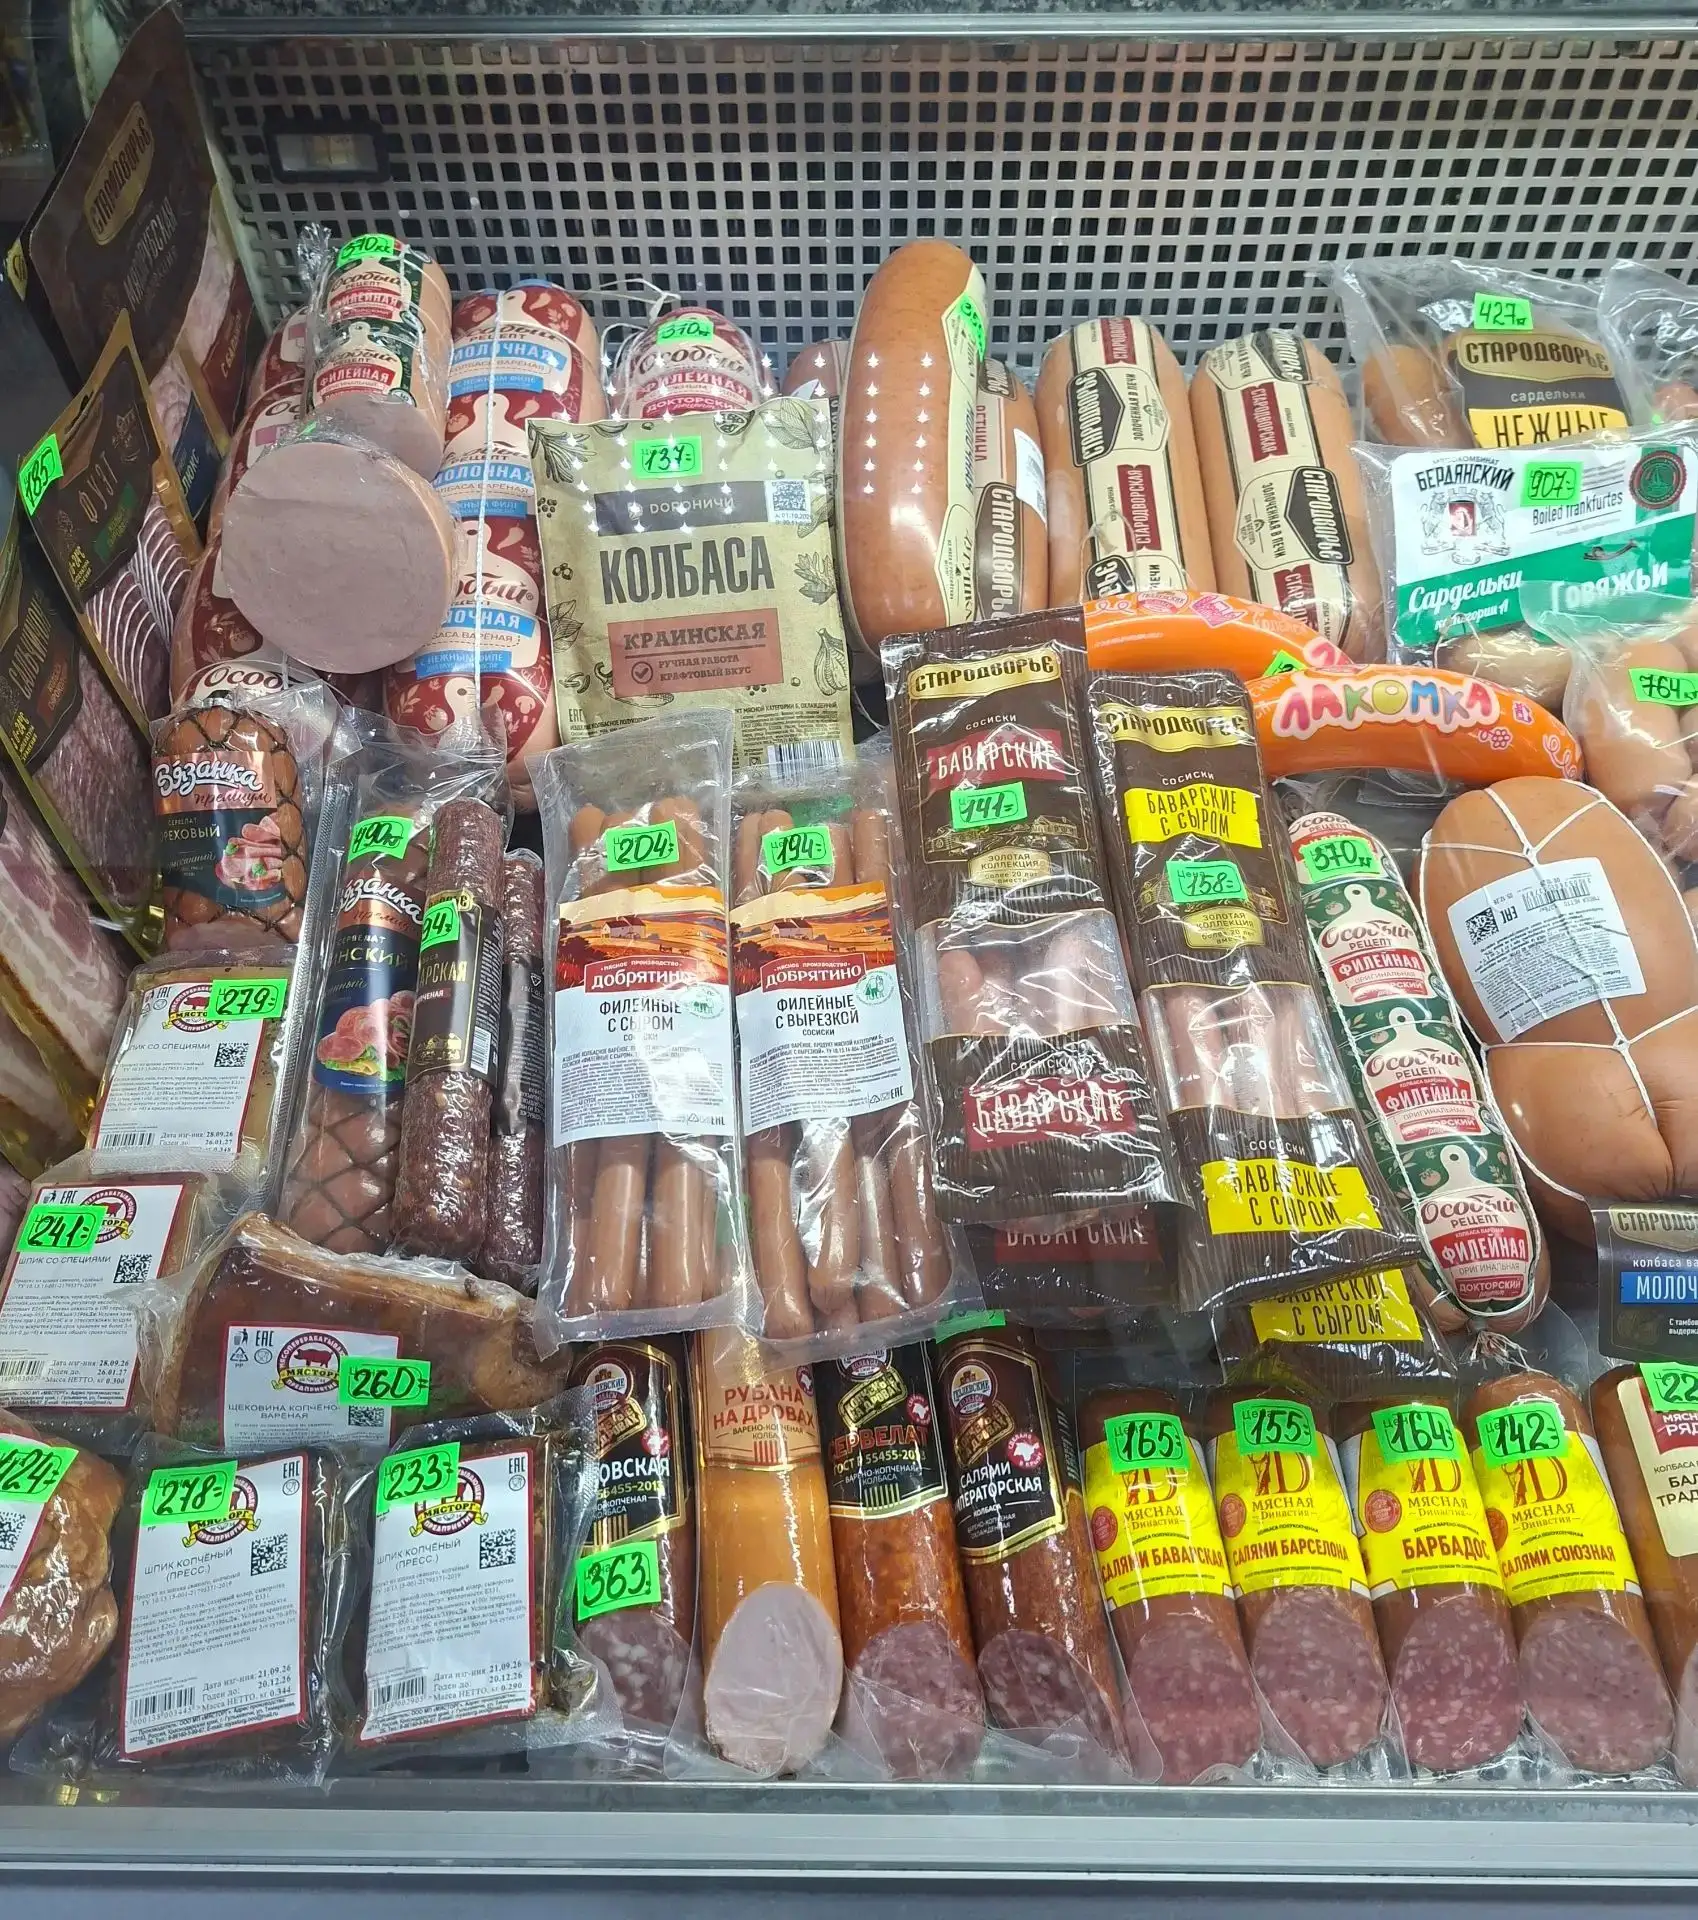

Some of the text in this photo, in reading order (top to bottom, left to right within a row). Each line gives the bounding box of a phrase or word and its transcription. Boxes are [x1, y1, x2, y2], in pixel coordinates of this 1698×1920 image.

[1465, 342, 1610, 373] СТАРОДВОРЬЕ
[319, 366, 391, 386] ФИЛЕЙНАЯ
[1129, 373, 1137, 393] ПЕЧИ
[1511, 390, 1586, 403] сардельки
[1075, 370, 1105, 461] СТАРОДВОРЬЕ
[1134, 401, 1145, 441] ЗОЛОЧЕННАЯ
[1256, 388, 1279, 455] СТАРОДВОРСКАЯ
[1415, 464, 1515, 492] БЕРДЯНСКИЙ
[1131, 468, 1151, 545] СТАРОДВОРСКАЯ
[1303, 470, 1343, 562] СТАРОДВОРЬЕ
[1532, 506, 1564, 526] Boiled
[1261, 482, 1280, 530] ЗОЛОЧЕННАЯ
[1273, 538, 1288, 558] ПЕЧИ
[600, 535, 776, 605] КОЛБАСА
[1409, 569, 1523, 614] Сардельки
[624, 622, 766, 650] КРАИНСКАЯ
[659, 654, 740, 669] РУЧНАЯ РАБОТА
[659, 666, 752, 682] КРАФТОВЫЙ ВКУС
[915, 655, 1054, 692] СТАРОДВОРЬЕ
[1281, 679, 1492, 731] ЛАКОМКА
[937, 740, 1054, 780] БАВАРСКИЕ
[1147, 788, 1237, 815] БАВАРСКИЕ
[1160, 811, 1231, 838] С СЫРОМ
[981, 860, 1039, 870] КОЛЛЕКЦИЯ
[988, 853, 1031, 862] ЗОЛОТАЯ
[1202, 912, 1246, 921] ЗОЛОТАЯ
[631, 959, 680, 969] ПРОИЗВОДСТВО
[1339, 953, 1422, 975] ФИЛЕЙНАЯ
[766, 965, 862, 988] ДОБРЯТИНО
[599, 998, 682, 1016] ФИЛЕЙНЫЕ
[777, 994, 854, 1012] ФИЛЕЙНЫЕ
[608, 1016, 673, 1033] С СЫРОМ
[775, 1008, 859, 1029] С ВЫРЕЗКОЙ
[802, 1028, 835, 1037] СОСИСКИ
[1365, 1048, 1461, 1077] Особый
[1386, 1083, 1473, 1111] ФИЛЕЙНАЯ
[1249, 1197, 1341, 1226] С СЫРОМ
[1421, 1195, 1517, 1225] Особый
[1451, 1214, 1499, 1229] РЕЦЕПТ
[1441, 1233, 1526, 1263] ФИЛЕЙНАЯ
[61, 1256, 112, 1264] СПЕЦИЯМИ
[1459, 1262, 1521, 1275] ОРИГИНАЛЬНАЯ
[1633, 1256, 1681, 1268] колбаса
[1459, 1280, 1521, 1293] ДОКТОРСКИЙ
[1292, 1303, 1385, 1335] С СЫРОМ
[228, 1404, 285, 1412] ЩЕКОВИНА
[714, 1404, 815, 1429] НА ДРОВАХ
[960, 1461, 1011, 1489] САЛЯМИ
[1653, 1461, 1695, 1474] КОЛБАСА
[424, 1500, 476, 1519] МЯСТОРГ
[1123, 1505, 1184, 1522] МЯСНАЯ
[1252, 1497, 1314, 1511] МЯСНАЯ
[1408, 1497, 1468, 1509] МЯСНАЯ
[1511, 1503, 1576, 1523] МЯСНАЯ
[377, 1538, 461, 1565] ШПИК КОПЧЁНЫЙ
[1232, 1539, 1349, 1566] САЛЯМИ БАРСЕЛОНА
[1402, 1537, 1491, 1560] БАРБАДОС
[144, 1547, 233, 1575] ШПИК КОПЧЁНЫЙ
[396, 1554, 439, 1571] (ПРЕСС.)
[1501, 1552, 1550, 1579] САЛЯМИ
[1553, 1546, 1616, 1563] СОЮЗНАЯ
[166, 1565, 211, 1583] (ПРЕСС.)
[202, 1664, 291, 1692] Дата 21.09.26
[433, 1659, 522, 1682] Дата 21.09.26
[489, 1671, 523, 1684] 20.12.26
[202, 1690, 225, 1701] Годен
[257, 1675, 291, 1689] 20.12.26
[269, 1686, 291, 1698] 0.344
[500, 1681, 523, 1691] 0.290
